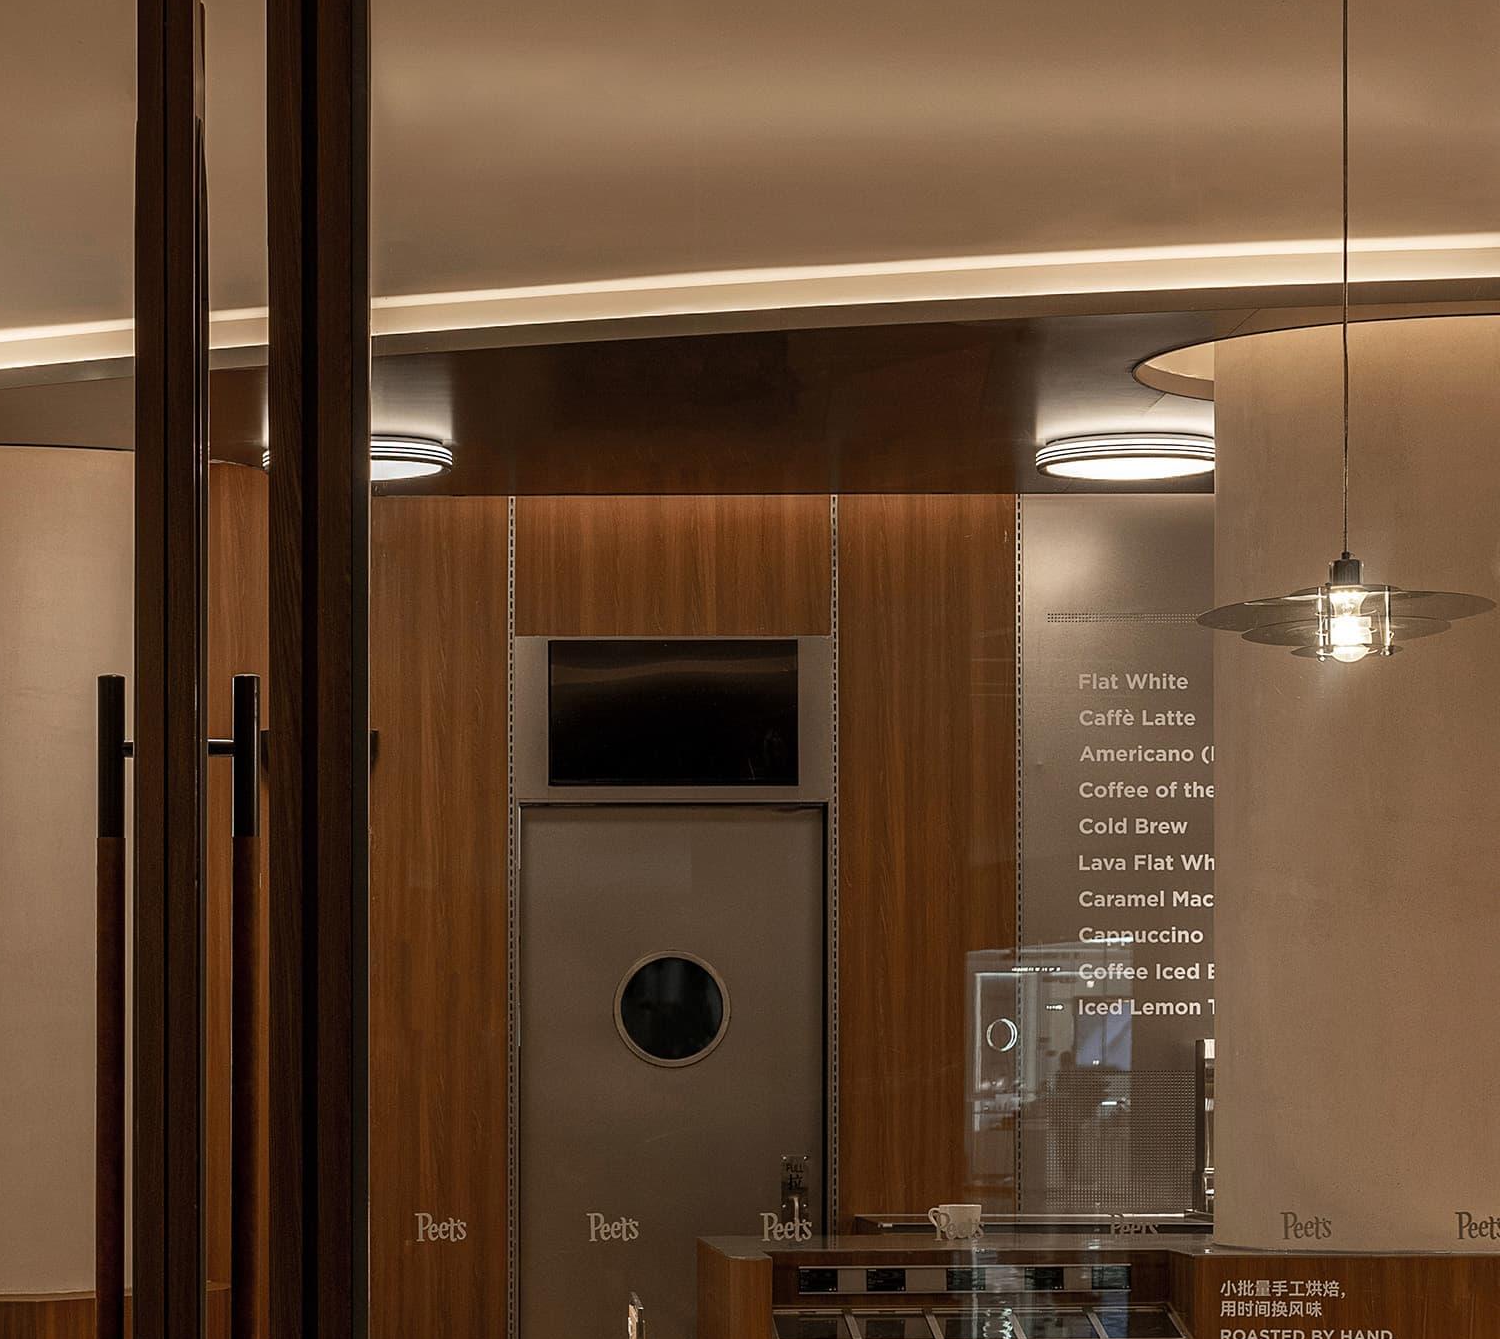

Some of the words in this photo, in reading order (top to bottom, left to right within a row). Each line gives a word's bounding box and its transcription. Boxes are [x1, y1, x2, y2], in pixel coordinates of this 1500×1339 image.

[1078, 672, 1119, 690] Flat
[1125, 672, 1189, 690] White
[1078, 708, 1135, 727] Caffè
[1142, 709, 1196, 727] Latte
[1079, 744, 1195, 762] Americano
[1078, 781, 1149, 799] Coffee
[1155, 781, 1178, 799] of
[1183, 781, 1215, 799] the
[1078, 817, 1128, 835] Cold
[1135, 818, 1188, 835] Brew
[1078, 854, 1126, 871] Lava
[1134, 853, 1175, 871] Flat
[1180, 853, 1215, 871] Wh
[1078, 890, 1165, 908] Caramel
[1172, 890, 1215, 908] Mac
[1078, 926, 1204, 947] Cappuccino
[1078, 962, 1149, 980] Coffee
[1155, 962, 1200, 980] Iced
[1078, 998, 1122, 1016] Iced
[1130, 998, 1202, 1016] Lemon
[414, 1212, 467, 1242] Peet's
[586, 1212, 639, 1242] Peet's
[760, 1212, 813, 1242] Peet's
[1280, 1211, 1332, 1240] Peet's
[1220, 1300, 1323, 1318] 用时间换风味
